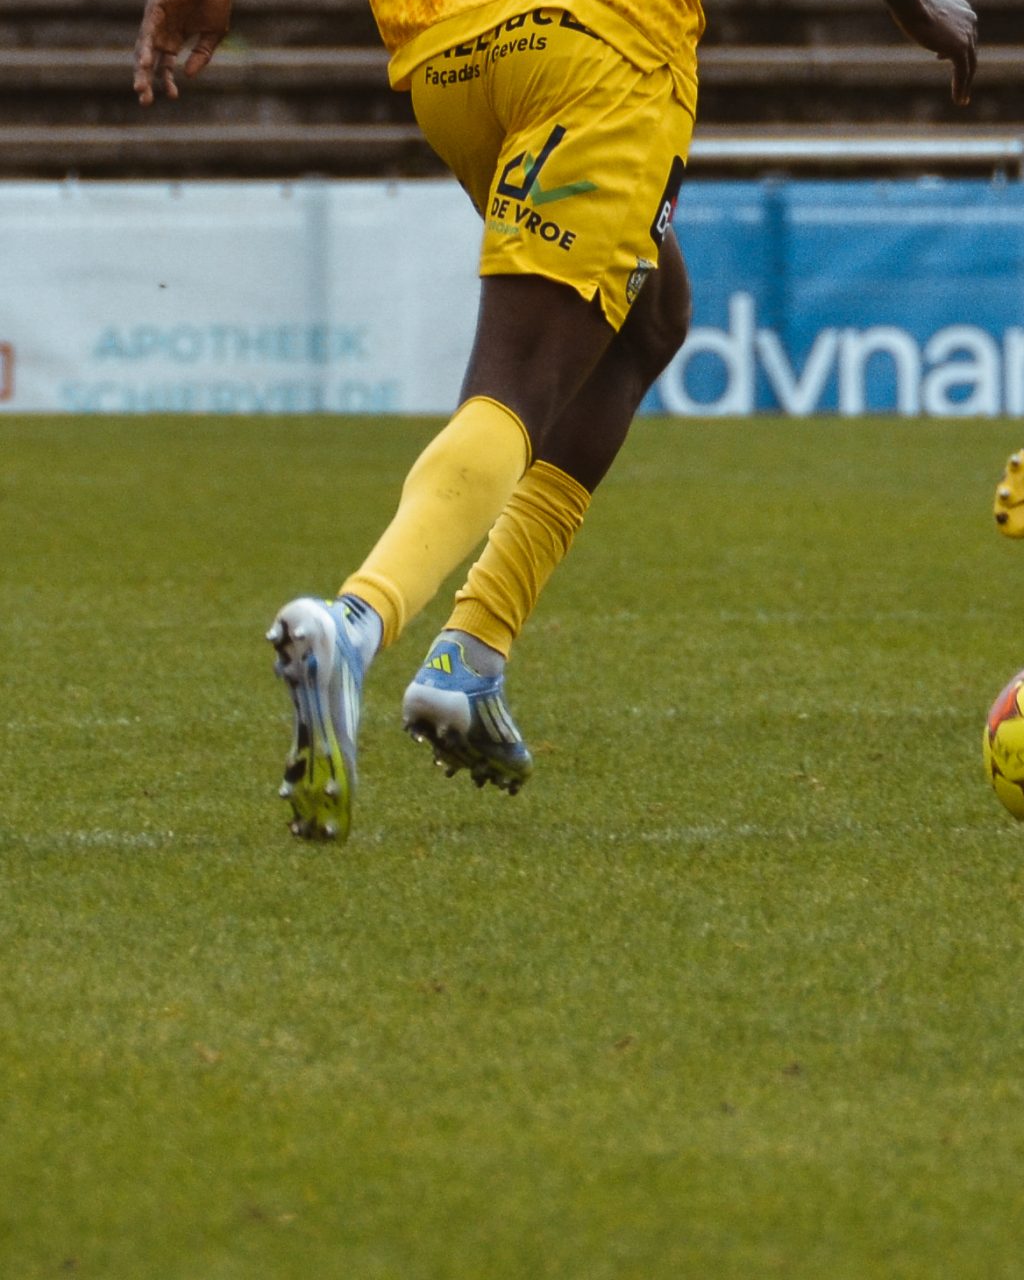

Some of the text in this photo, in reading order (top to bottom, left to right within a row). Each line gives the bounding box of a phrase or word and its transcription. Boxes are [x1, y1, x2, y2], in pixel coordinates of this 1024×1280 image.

[490, 198, 577, 252] DE VROE
[93, 324, 370, 363] APOTHEEK
